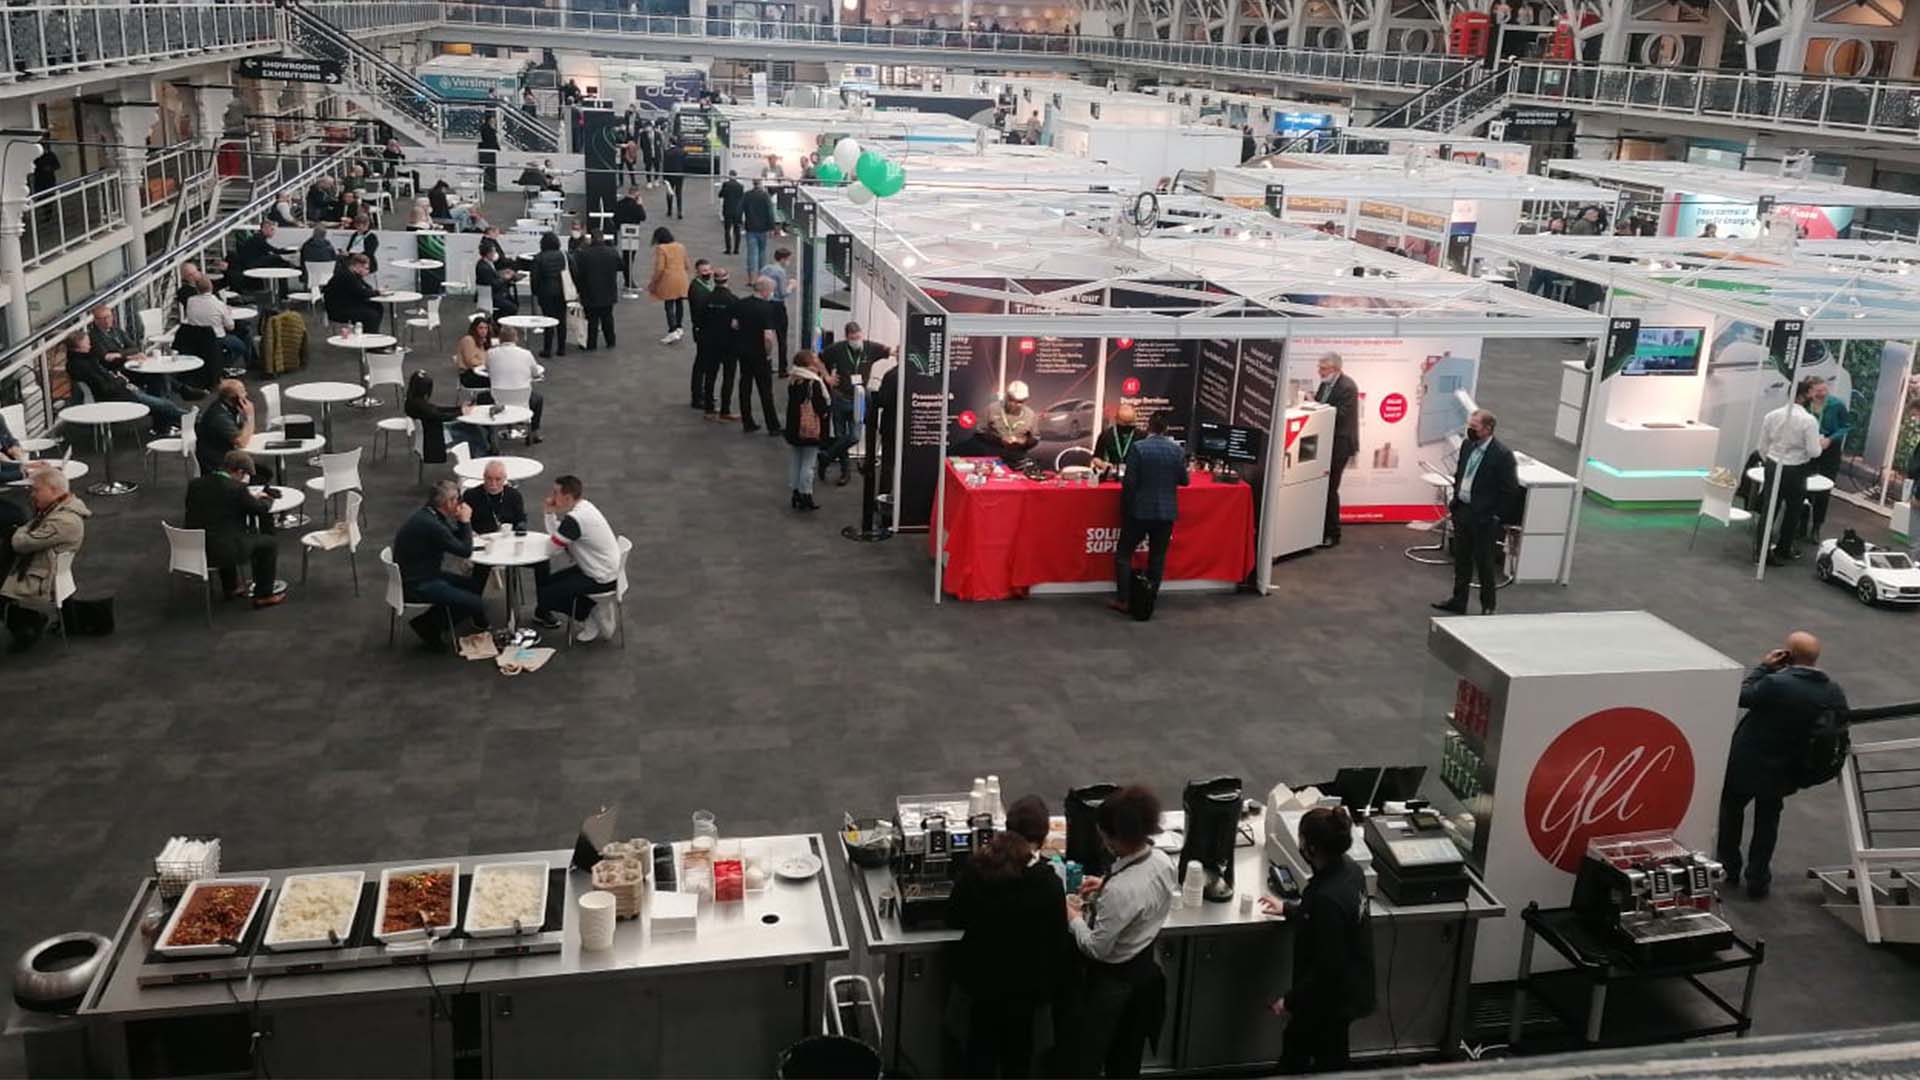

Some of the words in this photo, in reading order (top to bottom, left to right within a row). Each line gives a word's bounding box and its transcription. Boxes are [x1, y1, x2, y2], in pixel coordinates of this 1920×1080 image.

[262, 61, 321, 72] SHOWROOMS
[262, 69, 321, 80] EXHIBITIONS
[924, 316, 943, 327] E41
